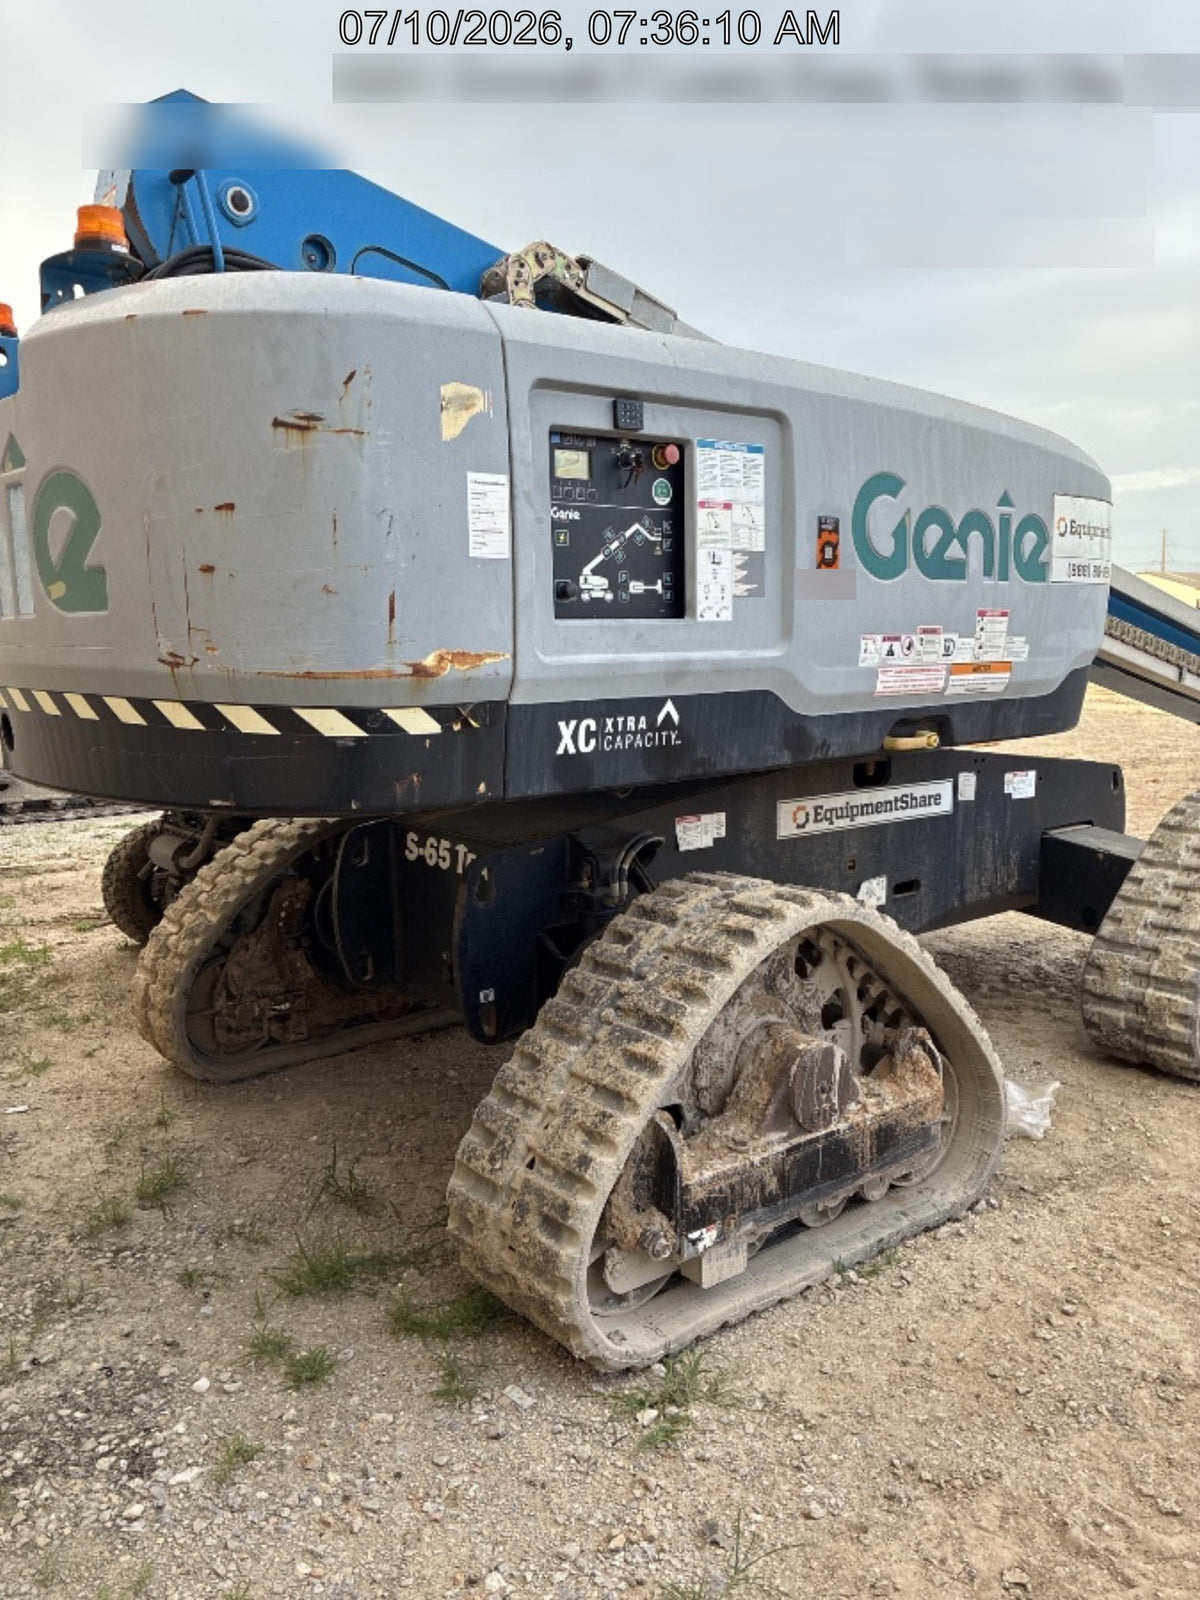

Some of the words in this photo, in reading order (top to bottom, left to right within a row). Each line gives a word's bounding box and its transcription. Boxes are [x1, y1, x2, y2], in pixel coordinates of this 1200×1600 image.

[550, 506, 581, 520] Genie
[852, 471, 1050, 583] Genie
[556, 718, 597, 755] XC
[604, 715, 647, 733] XTRA
[813, 792, 942, 826] EquipmentShare
[405, 831, 451, 870] S-65
